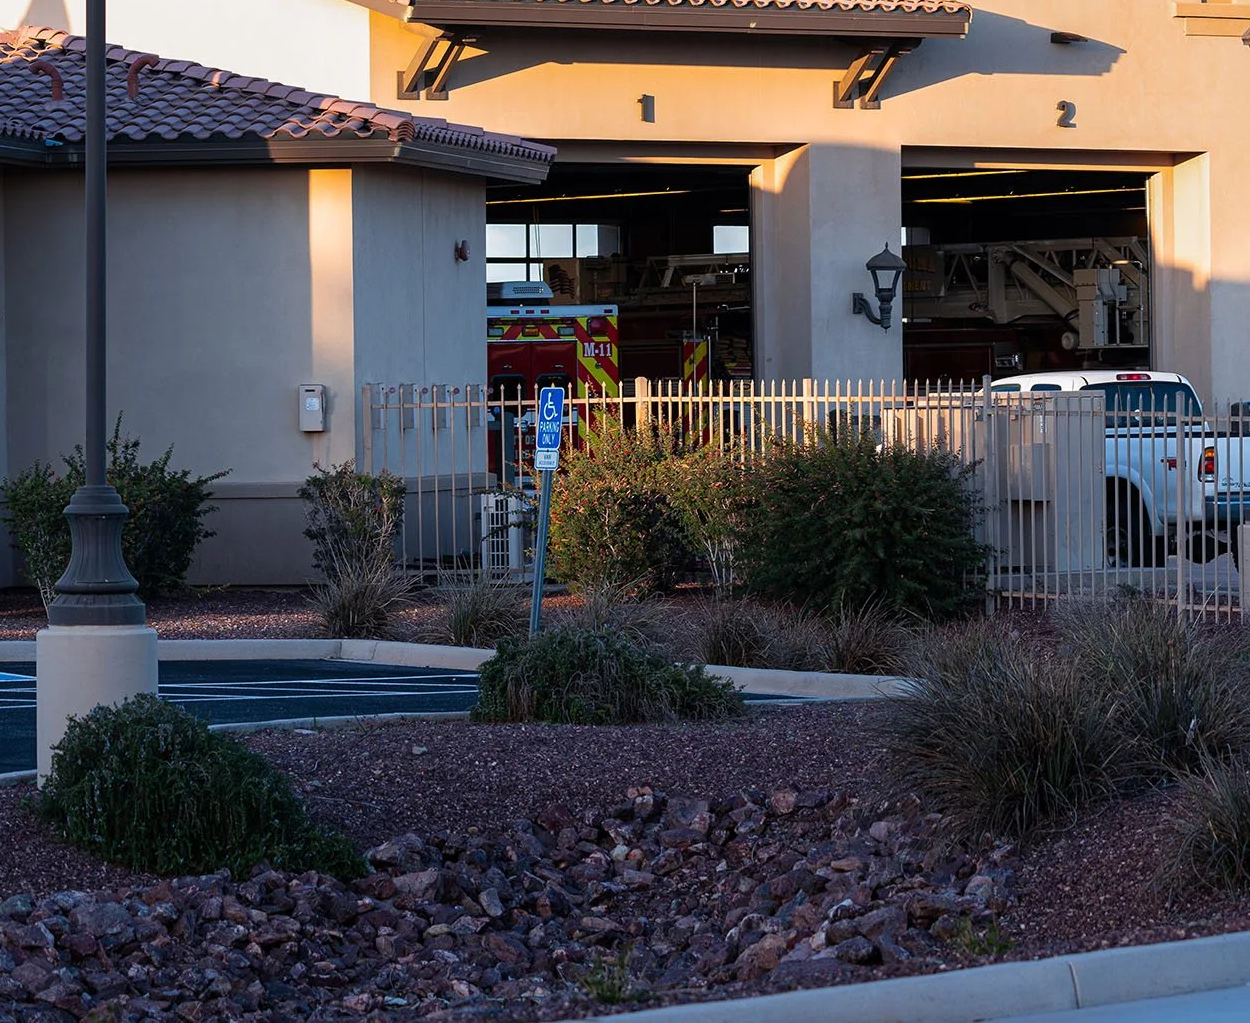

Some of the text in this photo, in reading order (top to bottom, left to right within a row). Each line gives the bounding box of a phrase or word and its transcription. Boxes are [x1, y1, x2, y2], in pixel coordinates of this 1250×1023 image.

[637, 94, 655, 123] 1
[1056, 100, 1076, 128] 2
[583, 342, 612, 357] M-11
[539, 421, 560, 433] PARKING
[542, 434, 556, 445] ONLY
